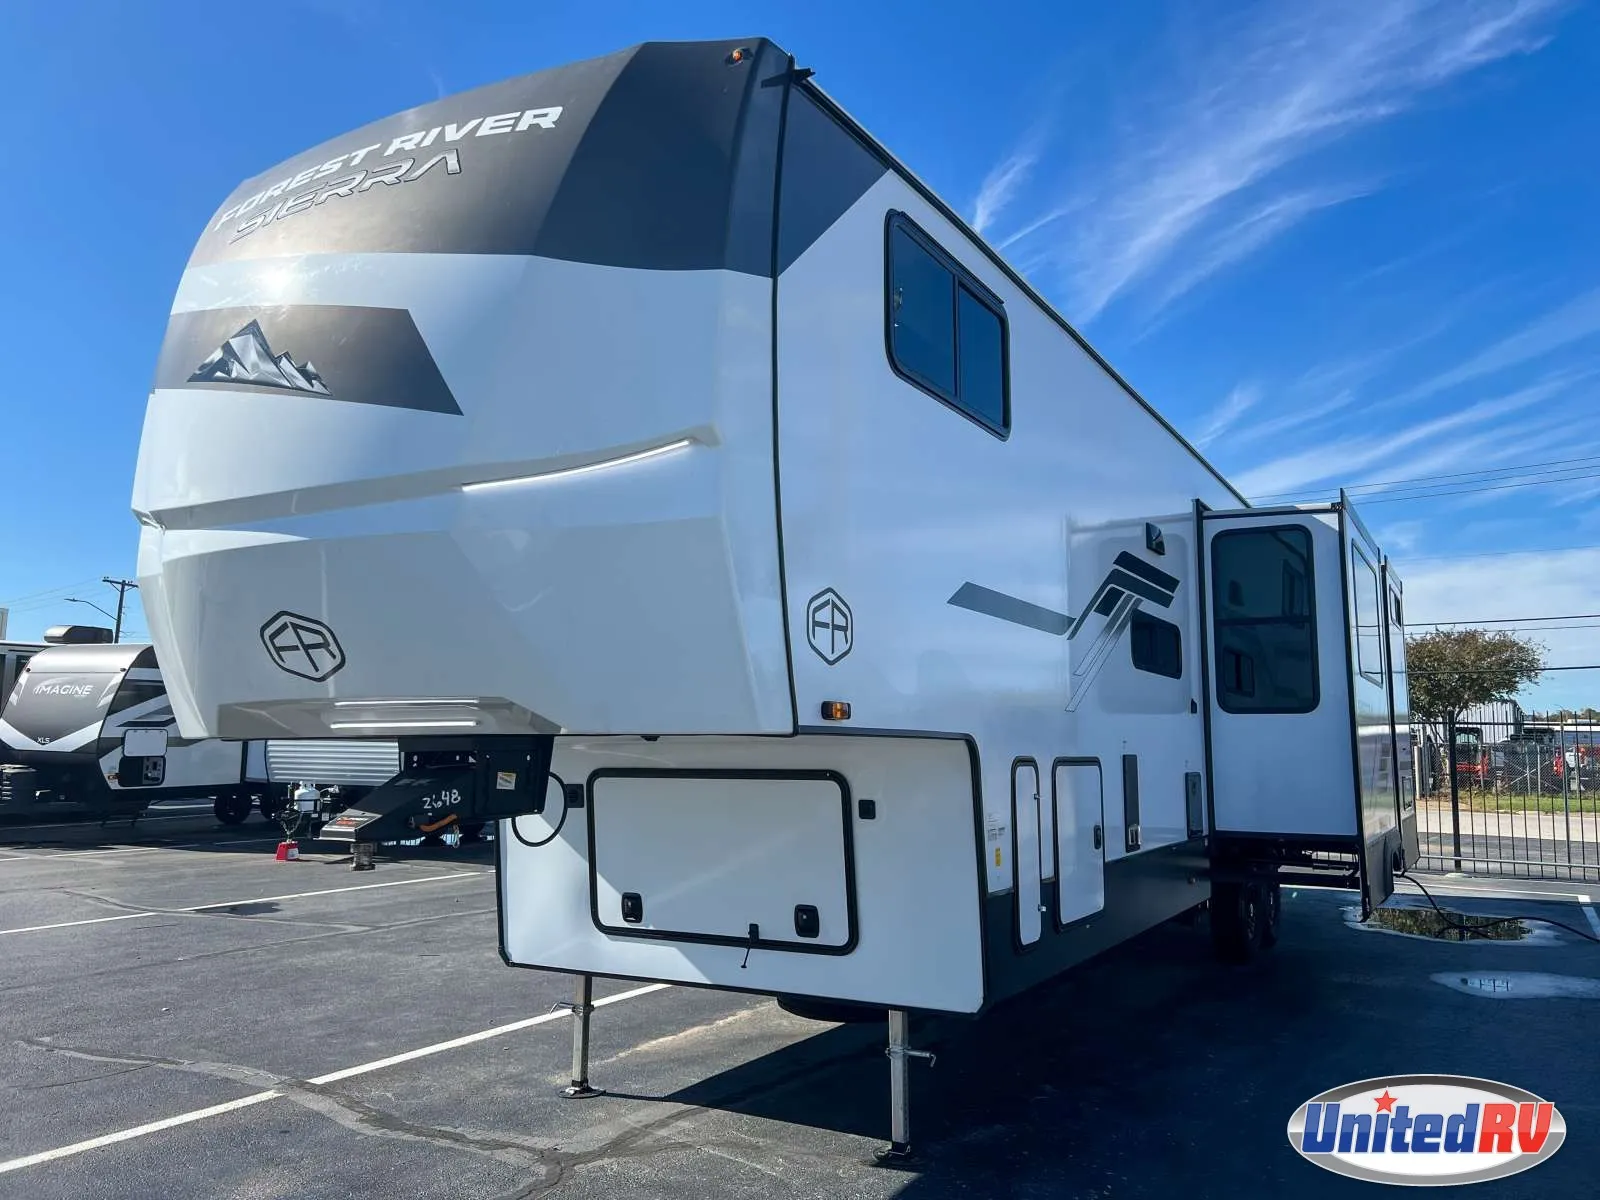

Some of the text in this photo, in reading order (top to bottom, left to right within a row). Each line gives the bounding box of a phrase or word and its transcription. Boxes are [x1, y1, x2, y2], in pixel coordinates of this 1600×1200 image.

[214, 106, 563, 231] FOREST RIVER
[230, 148, 462, 245] SIERRA
[34, 684, 93, 695] IMAGINE
[422, 789, 461, 809] 2648
